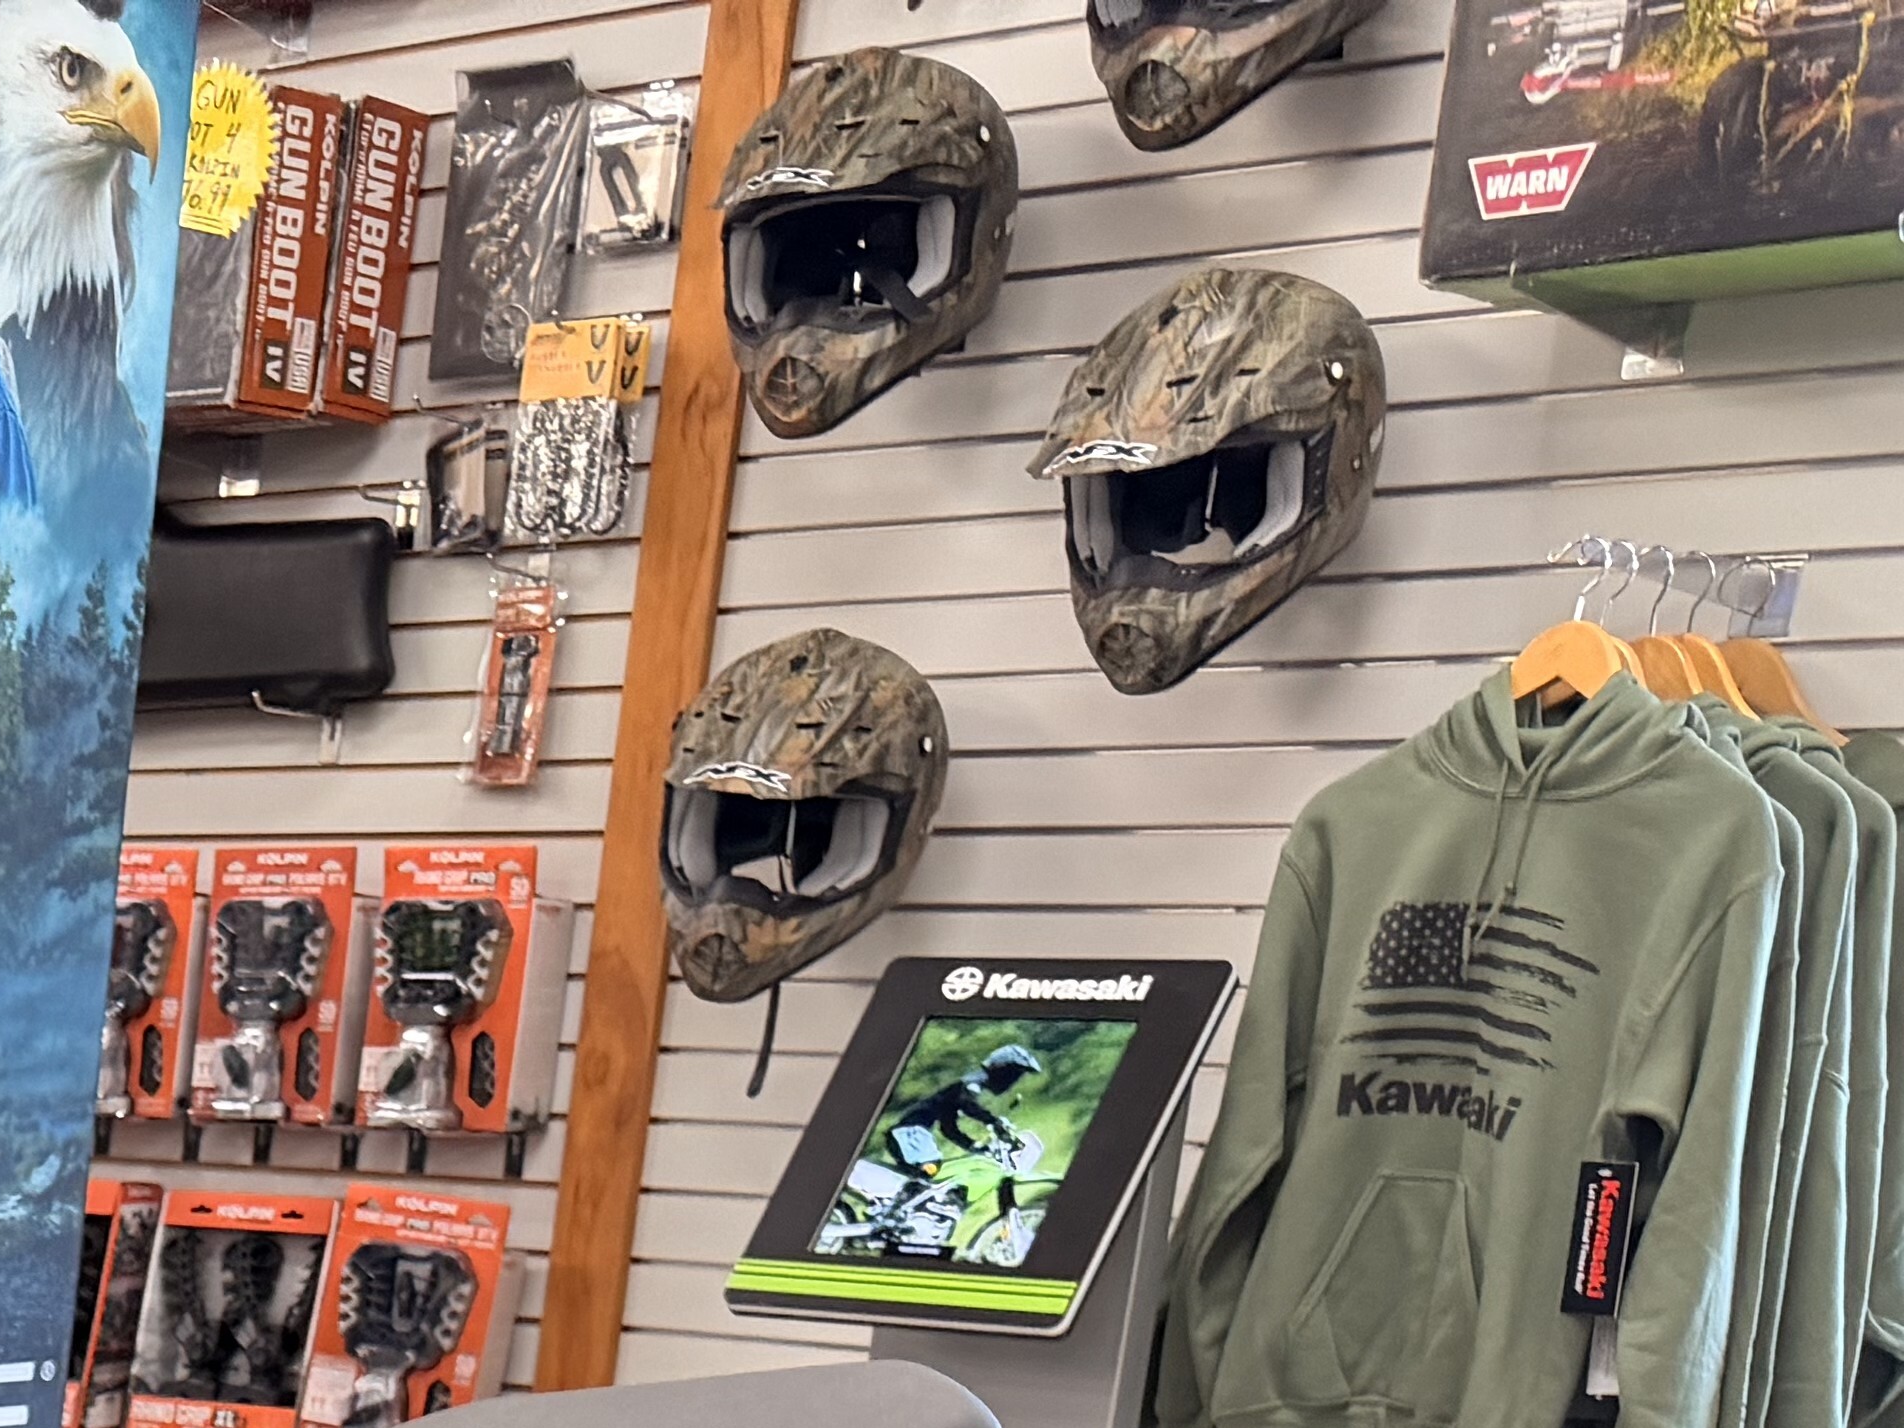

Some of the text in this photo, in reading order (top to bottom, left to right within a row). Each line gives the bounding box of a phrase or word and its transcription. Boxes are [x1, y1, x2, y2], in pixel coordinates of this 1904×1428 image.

[196, 79, 241, 115] GUN
[191, 121, 242, 154] OT 4
[313, 113, 337, 237] KOLPIN
[398, 128, 424, 249] KOLPIN
[1486, 166, 1569, 201] WARN
[264, 104, 315, 384] GUN BOOT IV
[346, 116, 403, 390] GUN BOOT IV
[256, 852, 309, 866] KOLPIN
[430, 851, 485, 864] KOLPIN
[983, 973, 1154, 1001] Kawasaki
[1337, 1070, 1522, 1142] Kawaki
[217, 1204, 275, 1222] KOLPIN
[396, 1196, 459, 1217] KOLPIN
[1586, 1180, 1621, 1299] Kawasaki
